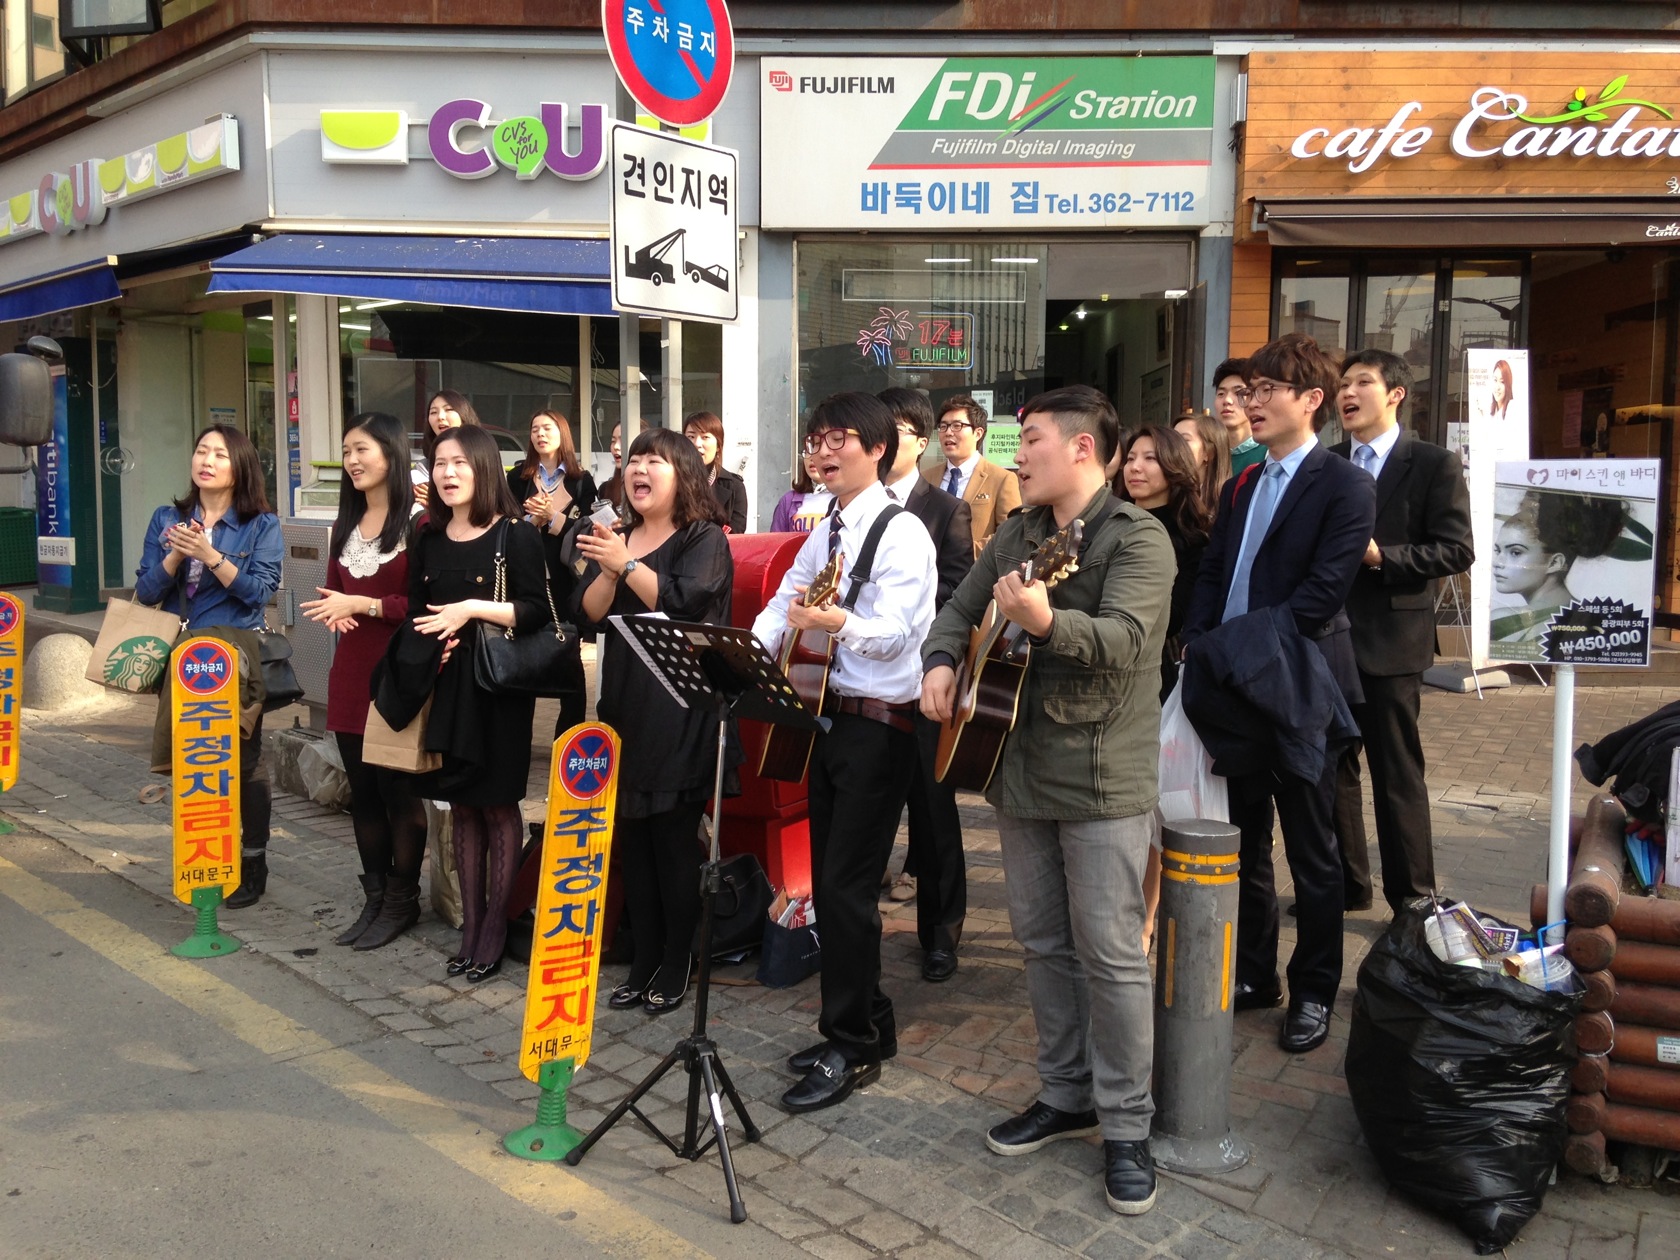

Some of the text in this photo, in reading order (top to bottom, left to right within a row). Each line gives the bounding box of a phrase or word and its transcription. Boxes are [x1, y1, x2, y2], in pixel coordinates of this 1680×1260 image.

[626, 6, 716, 58] 주차금지
[800, 77, 895, 94] FUJIFILM
[1069, 90, 1198, 119] Station
[502, 121, 527, 143] CVS
[516, 132, 533, 145] for
[1291, 101, 1433, 174] cafe
[509, 139, 538, 165] YOU
[931, 138, 1136, 159] Fujifilm Digital Imaging
[623, 153, 728, 216] 견인지역
[860, 181, 1195, 214] 바둑이네 집 Tel. 362-7112
[912, 348, 967, 362] FUJIFILM
[185, 663, 224, 674] 주정차금지
[568, 757, 608, 771] 주정차금지
[179, 700, 234, 865] 주정차금지
[180, 865, 234, 883] 서대문구
[536, 806, 608, 1031] 주정차금지
